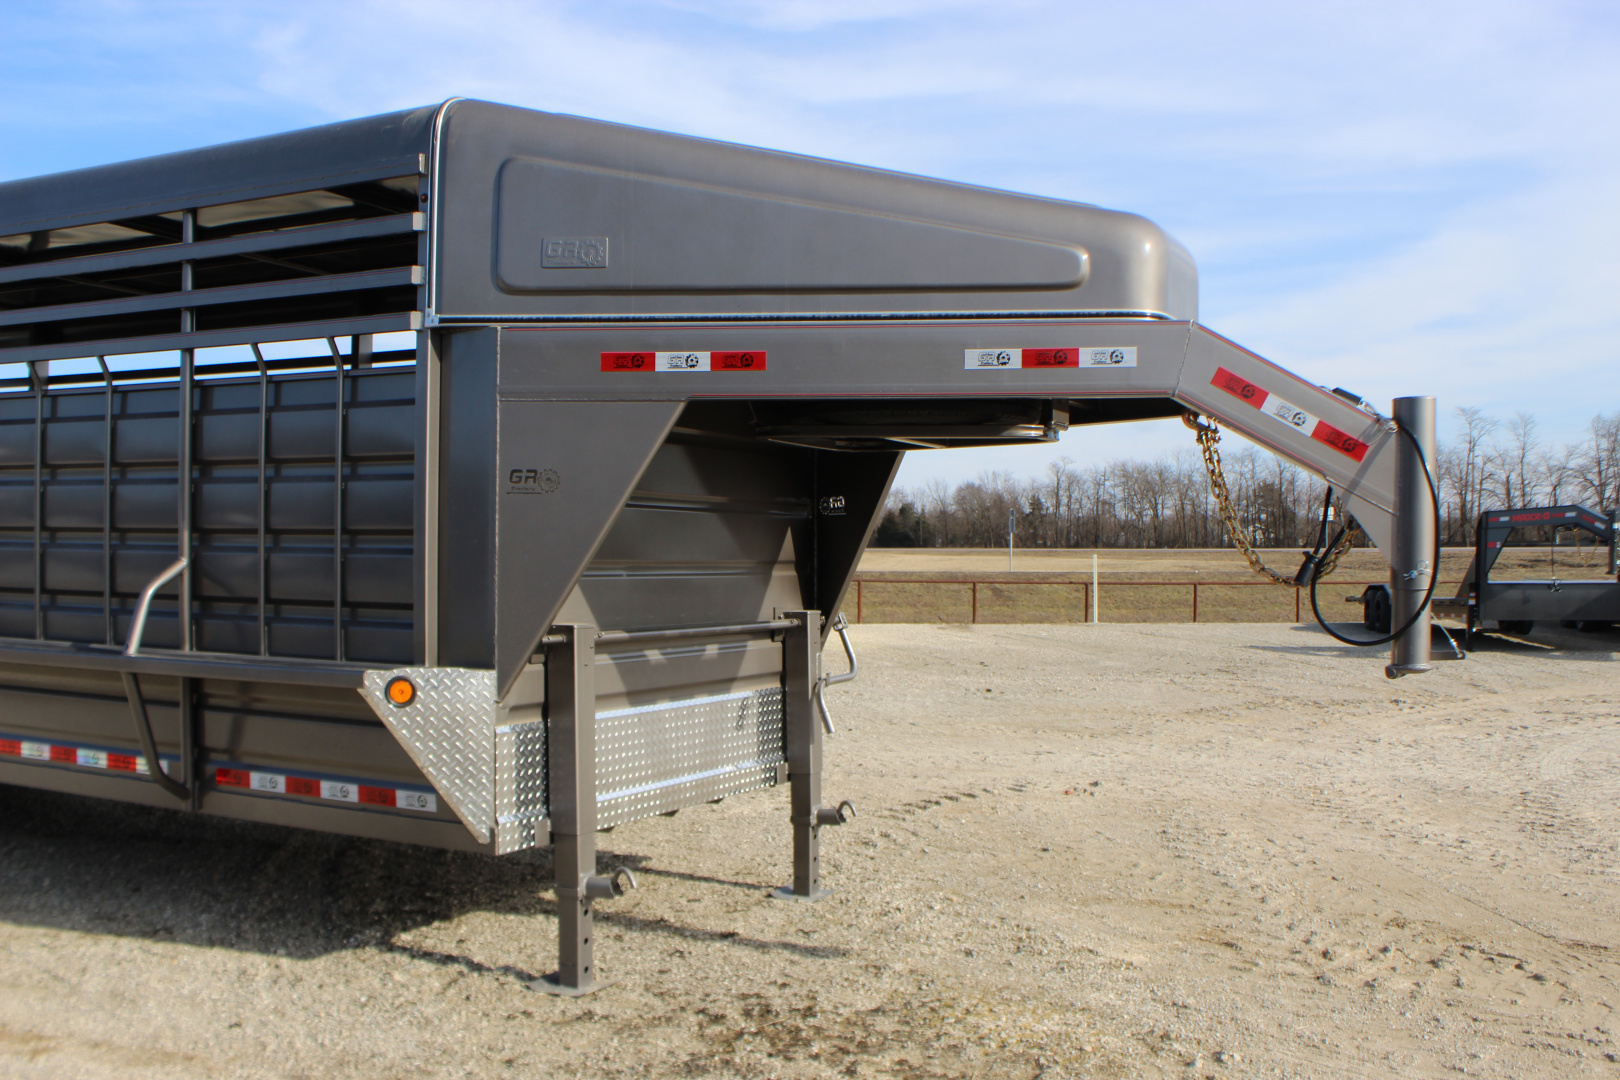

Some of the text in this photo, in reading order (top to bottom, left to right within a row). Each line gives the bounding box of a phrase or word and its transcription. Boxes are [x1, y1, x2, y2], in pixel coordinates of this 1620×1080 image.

[978, 352, 996, 362] GR
[1091, 350, 1109, 361] GR
[509, 469, 538, 484] GR
